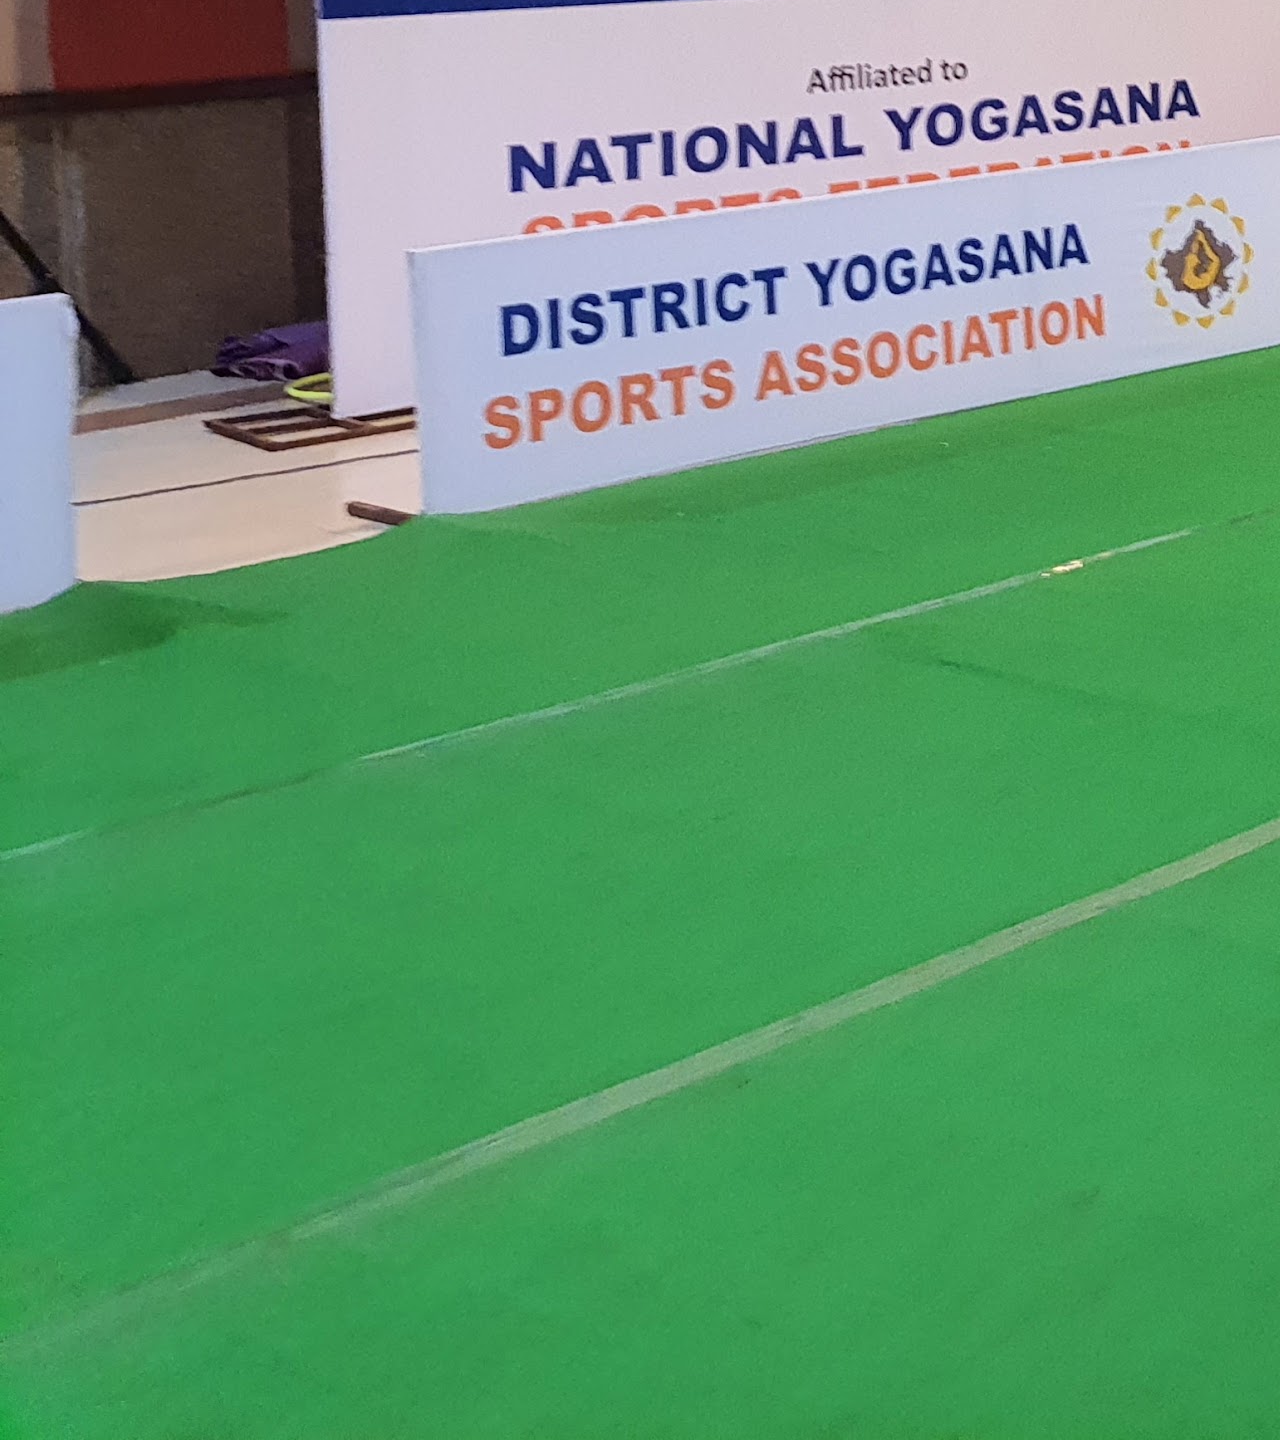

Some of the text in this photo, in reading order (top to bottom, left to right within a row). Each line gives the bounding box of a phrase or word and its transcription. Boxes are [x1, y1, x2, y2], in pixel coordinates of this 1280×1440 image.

[510, 115, 863, 192] NATIONAL
[883, 78, 1200, 152] YOGASANA
[807, 58, 968, 94] Affiliated to
[502, 224, 1088, 356] DISTRICT YOGASANA
[486, 296, 1105, 449] SPORTS ASSOCIATION
